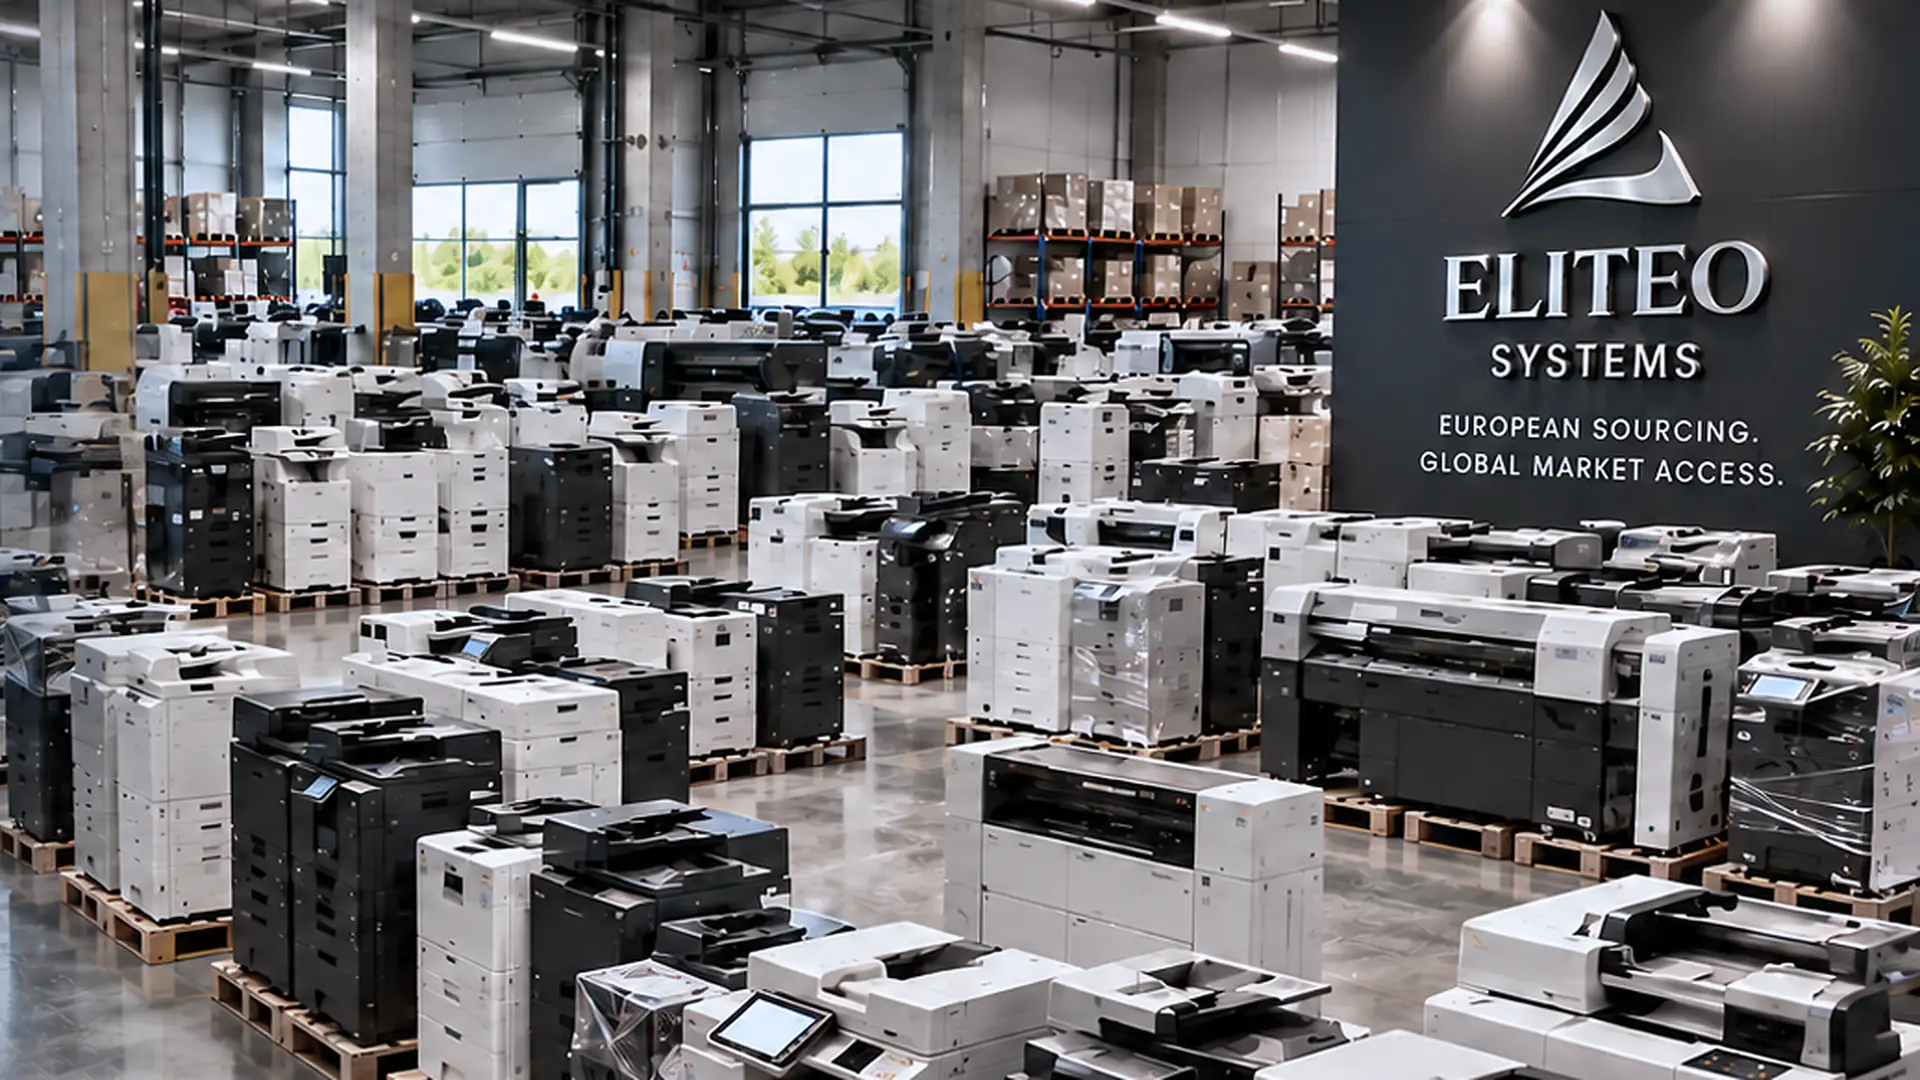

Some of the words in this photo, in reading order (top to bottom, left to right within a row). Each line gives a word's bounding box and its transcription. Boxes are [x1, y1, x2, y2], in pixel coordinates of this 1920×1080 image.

[1443, 240, 1770, 321] ELITEO
[1491, 342, 1702, 379] SYSTEMS
[1439, 414, 1580, 439] EUROPEAN
[1592, 417, 1760, 444] SOURCING.
[1420, 451, 1521, 476] GLOBAL
[1532, 454, 1645, 481] MARKET
[1654, 459, 1784, 486] ACCESS.
